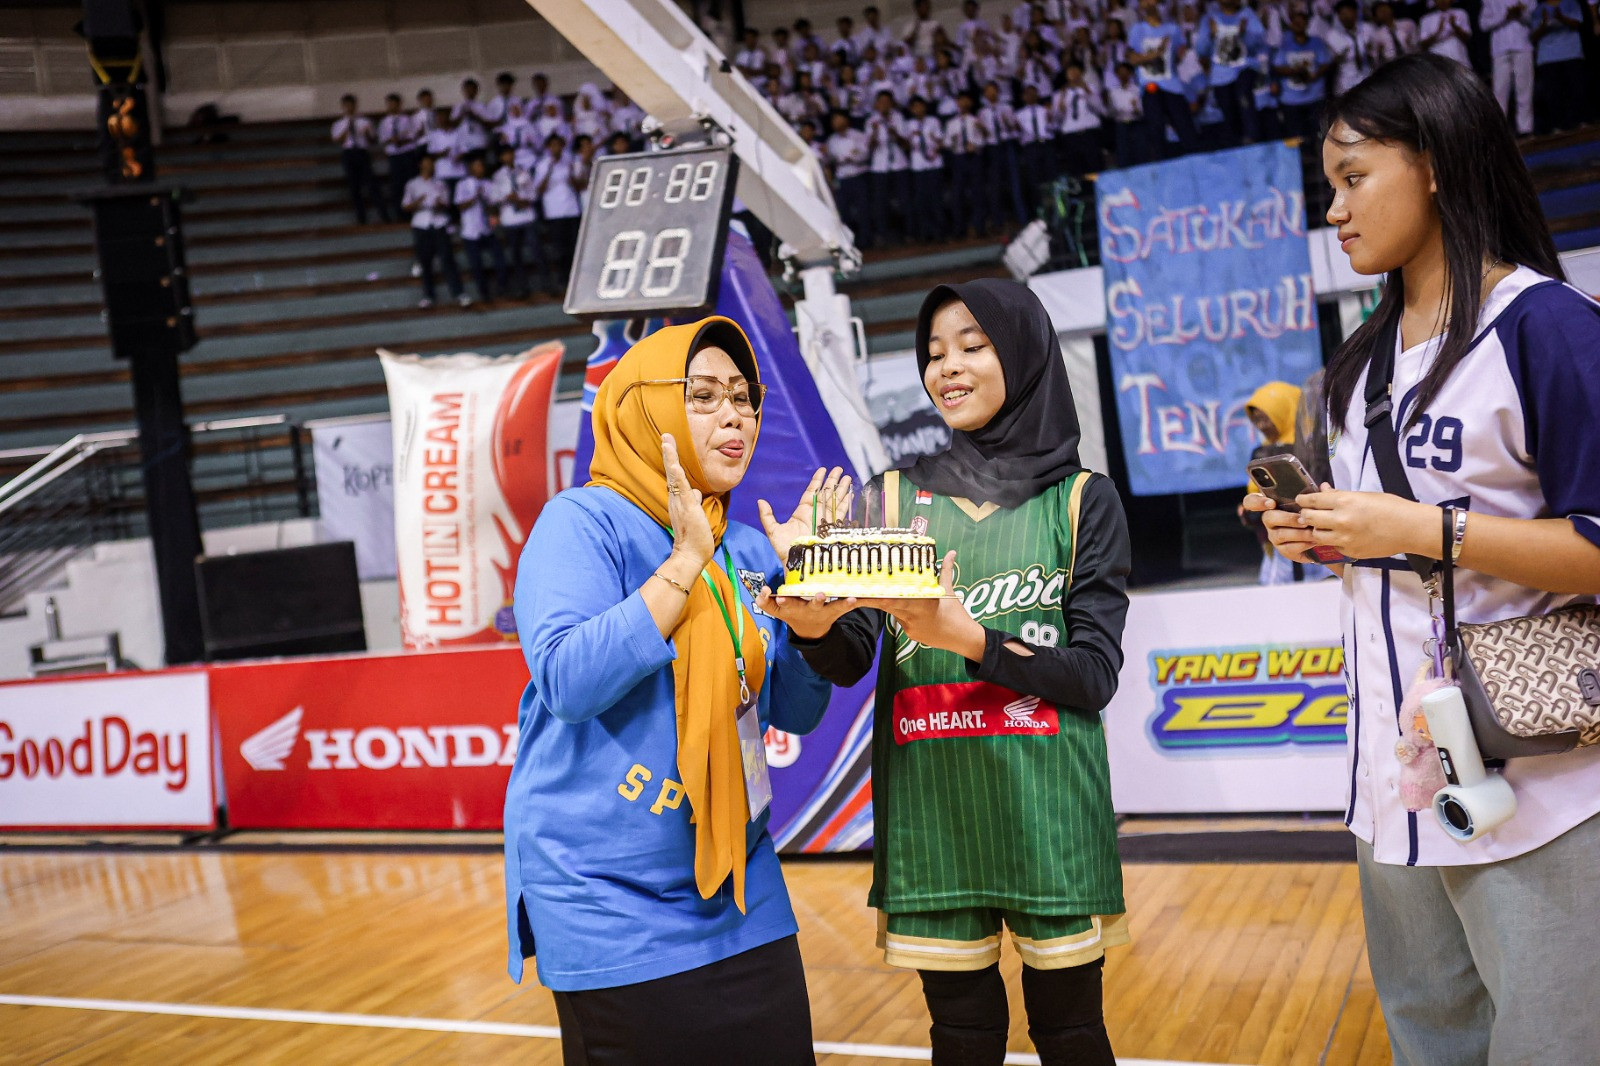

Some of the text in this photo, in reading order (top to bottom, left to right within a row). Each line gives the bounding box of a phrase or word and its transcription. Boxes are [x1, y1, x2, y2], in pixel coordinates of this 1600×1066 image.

[1101, 187, 1308, 263] SATUKAN
[597, 228, 691, 299] 88
[1107, 272, 1316, 350] SELURUH
[423, 392, 464, 515] CREAM
[1405, 413, 1464, 473] 29
[426, 559, 462, 627] HOT
[1155, 652, 1261, 685] YANG
[899, 710, 987, 736] One HEART.
[1003, 719, 1050, 729] HONDA
[617, 763, 696, 824] SP
